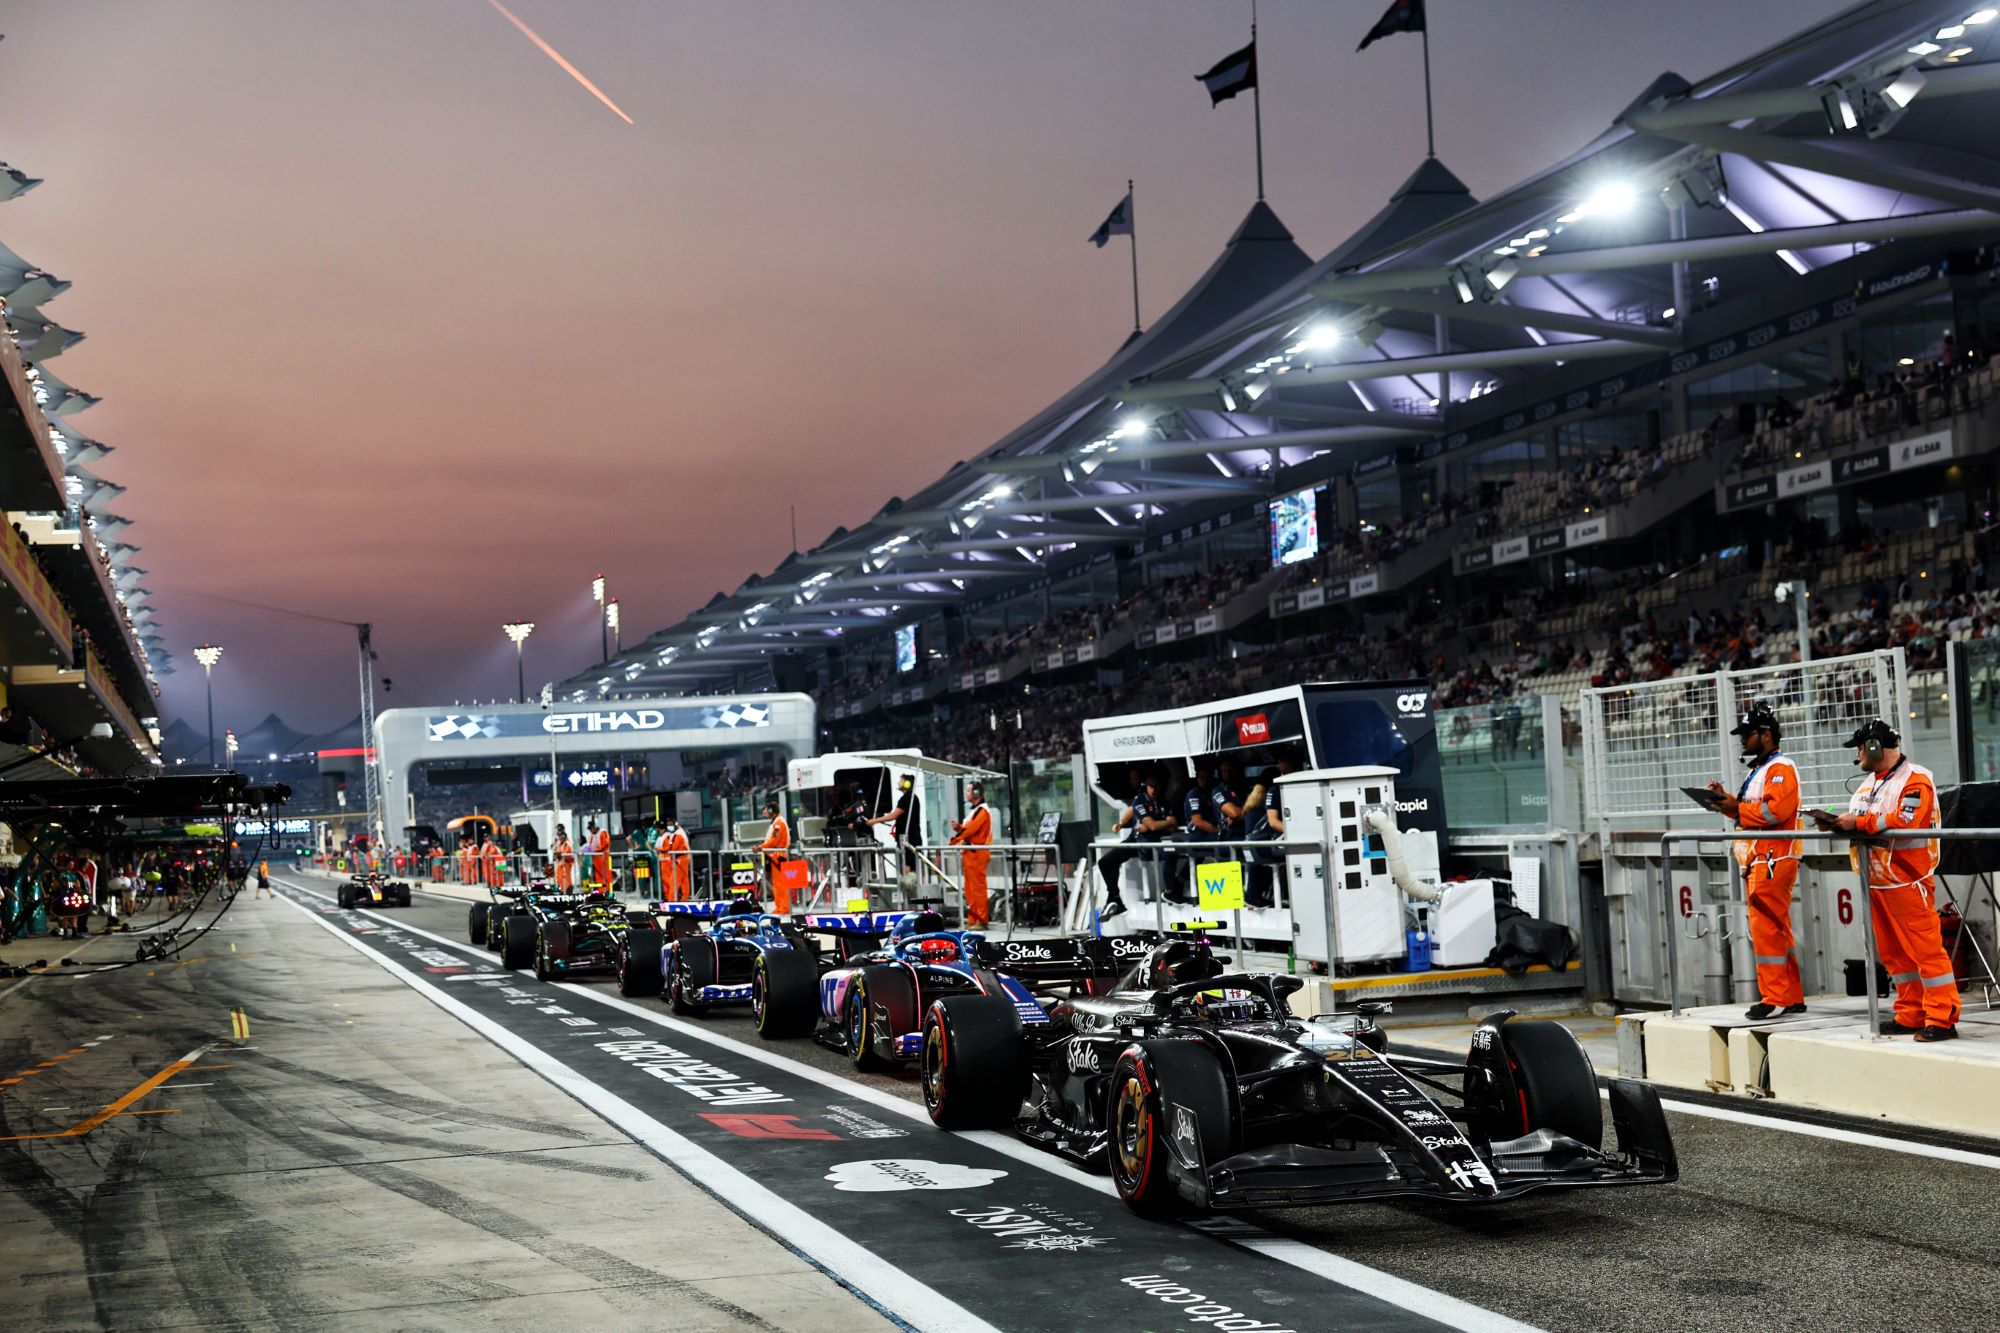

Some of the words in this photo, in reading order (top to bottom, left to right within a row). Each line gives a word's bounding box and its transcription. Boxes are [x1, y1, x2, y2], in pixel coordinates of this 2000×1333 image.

[1914, 442, 1940, 456] ALDAR
[1854, 456, 1879, 471] ALDAR
[1798, 471, 1821, 484] ALDAR
[542, 710, 665, 733] ETIHAD
[1204, 877, 1225, 895] W
[540, 894, 590, 902] PETRON
[1679, 885, 1693, 919] 6
[1837, 888, 1854, 925] 6
[1005, 943, 1052, 961] Stake
[1110, 939, 1158, 957] Stake
[929, 975, 955, 985] ALPINE
[1115, 1015, 1136, 1027] Stake
[1066, 1037, 1101, 1074] Stake
[1177, 1108, 1195, 1145] Stake
[948, 1206, 1062, 1237] MSC
[1120, 1275, 1297, 1333] pto.com
